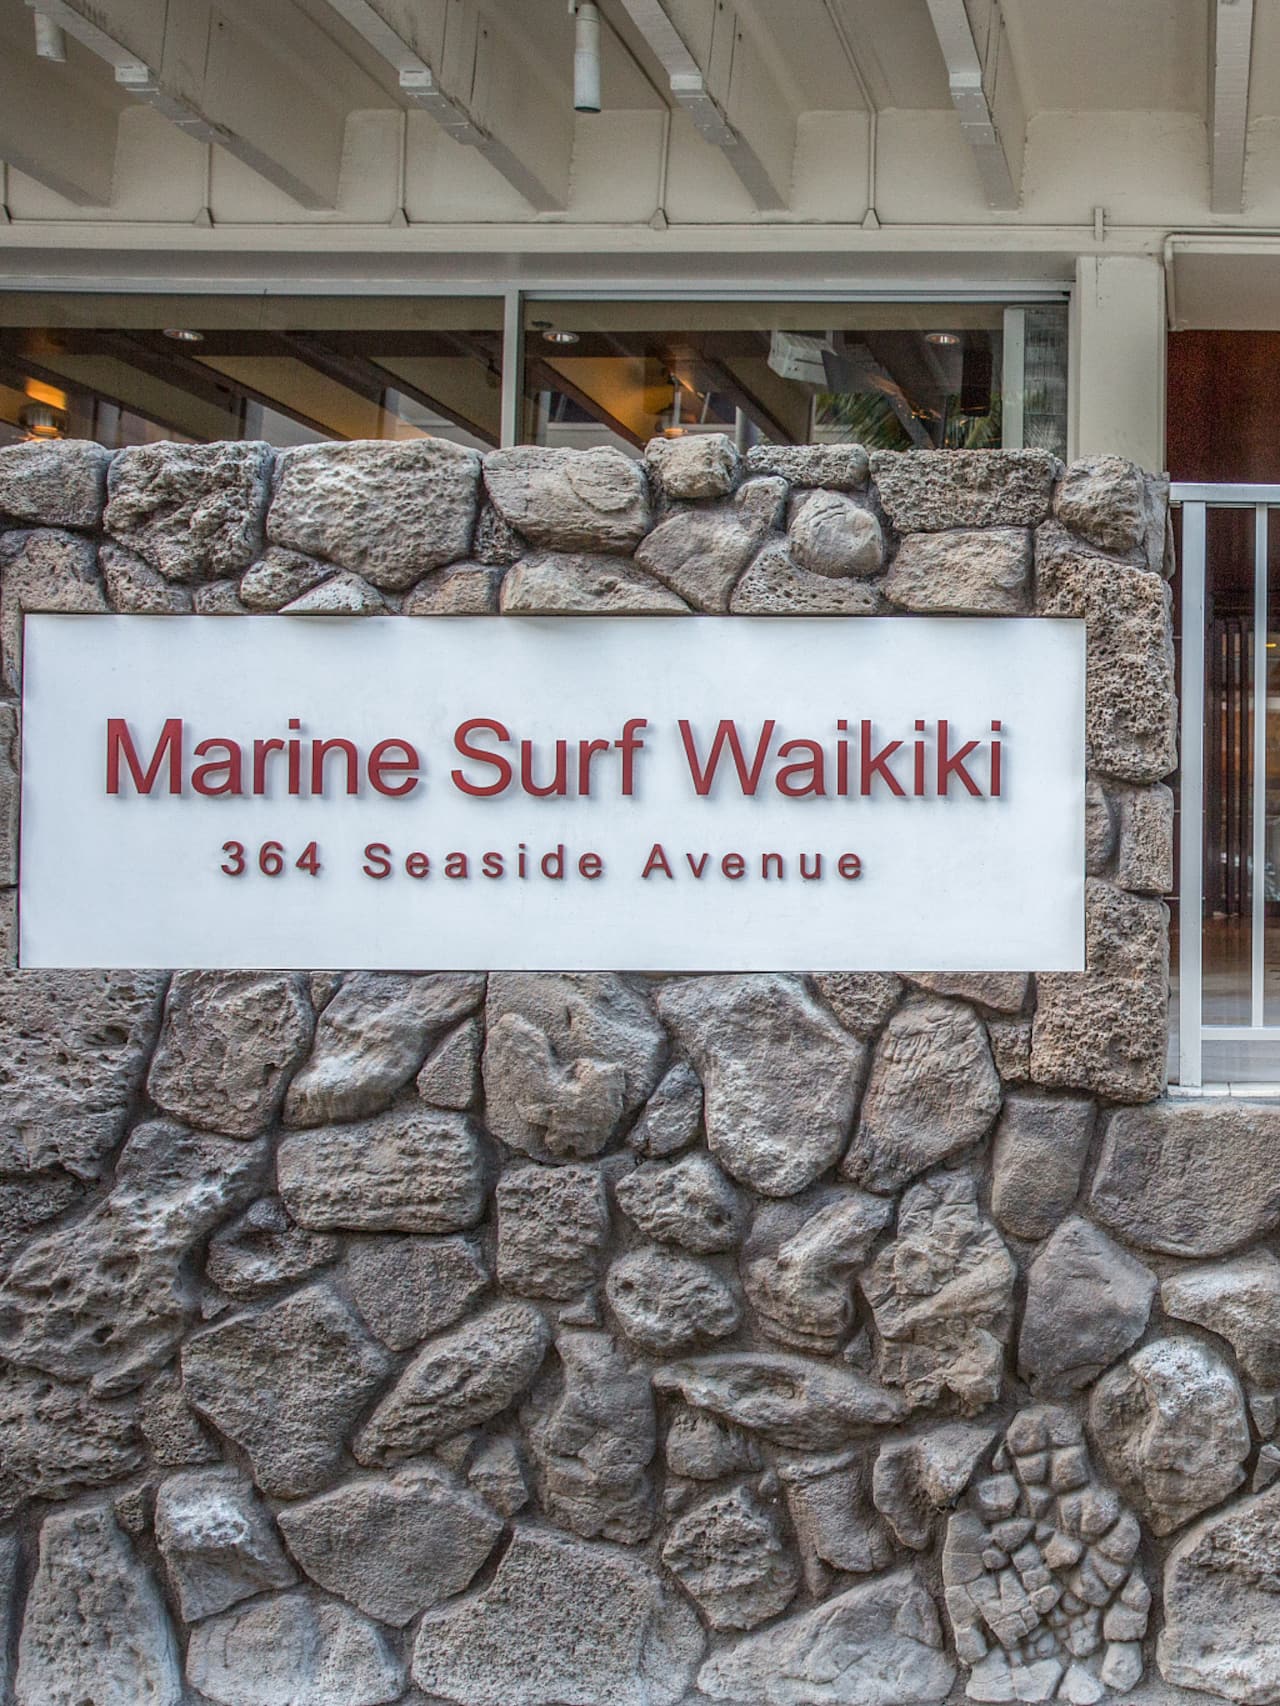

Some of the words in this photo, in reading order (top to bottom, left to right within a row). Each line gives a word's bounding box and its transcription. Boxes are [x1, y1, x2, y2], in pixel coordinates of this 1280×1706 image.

[106, 718, 420, 797] Marine
[450, 718, 648, 797] Surf
[678, 719, 1002, 797] Waikiki
[221, 841, 322, 877] 364
[362, 842, 603, 880] Seaside
[642, 843, 864, 880] Avenue
